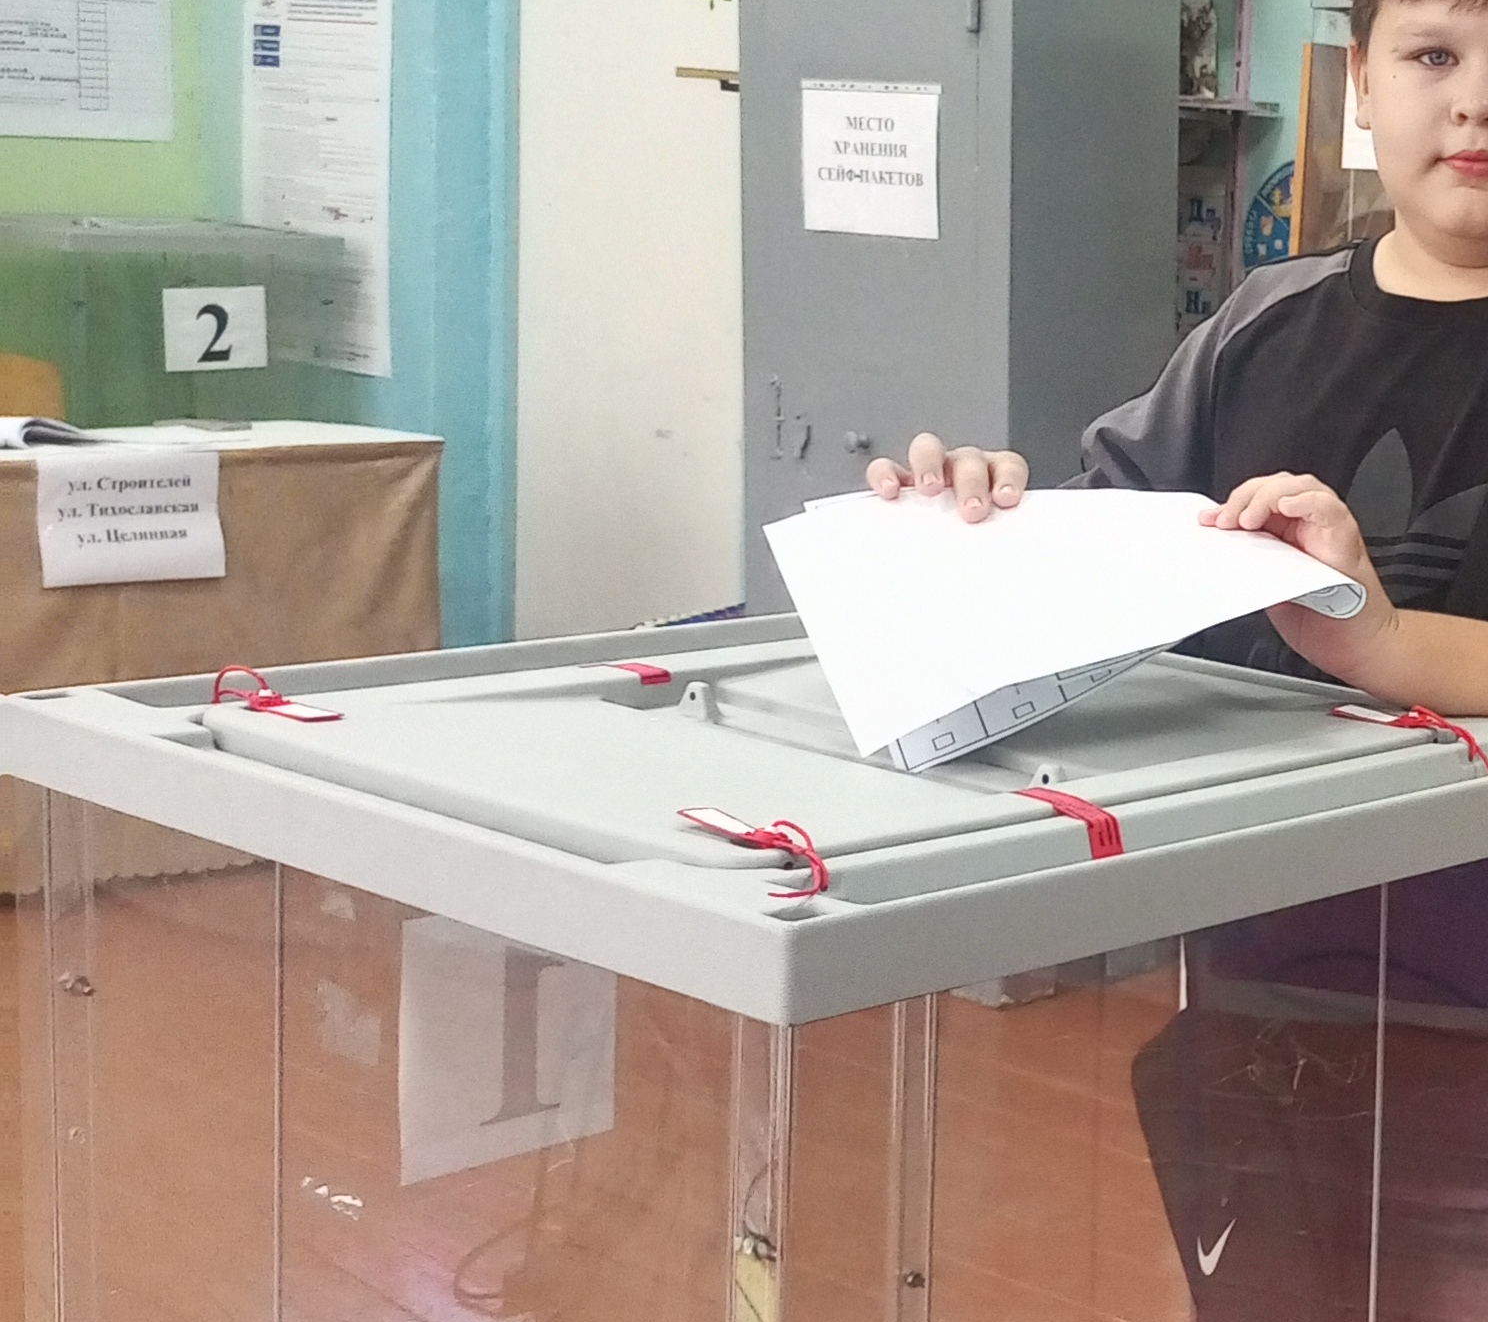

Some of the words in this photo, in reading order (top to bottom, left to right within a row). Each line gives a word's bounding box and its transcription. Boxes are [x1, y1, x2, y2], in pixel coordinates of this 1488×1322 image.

[846, 116, 895, 133] МЕСТО
[834, 140, 908, 158] ХРАНЕНИЯ
[817, 165, 924, 187] СЕЙФ-ПАКЕТОВ
[195, 303, 233, 363] 2
[67, 480, 92, 496] ул.
[96, 475, 192, 493] Строителей
[57, 507, 82, 522] ул.
[76, 532, 101, 550] ул.
[105, 528, 188, 545] Целинная
